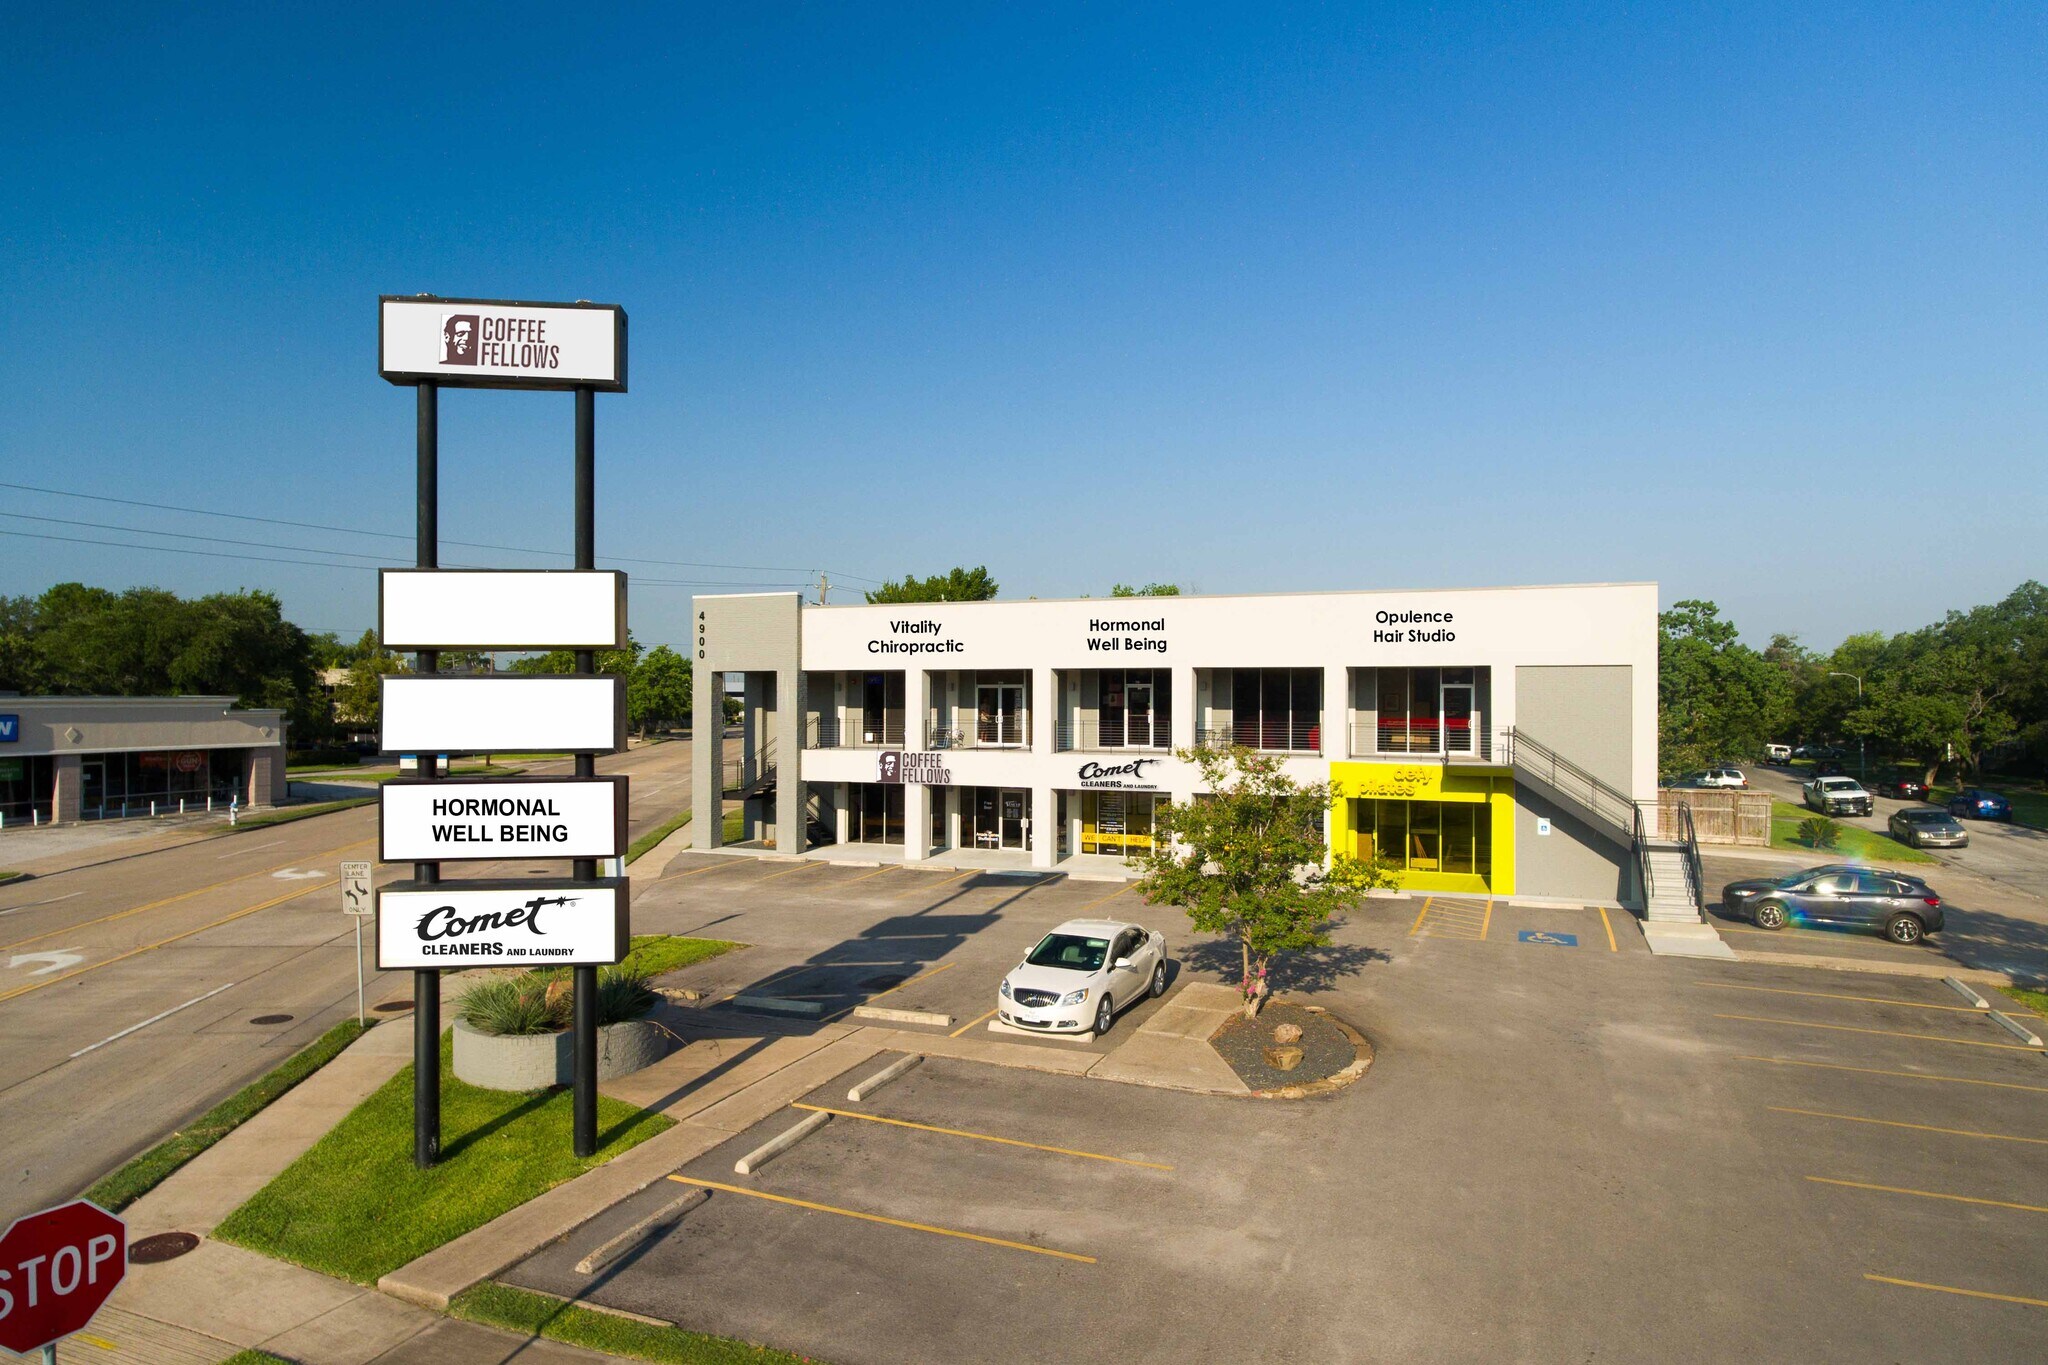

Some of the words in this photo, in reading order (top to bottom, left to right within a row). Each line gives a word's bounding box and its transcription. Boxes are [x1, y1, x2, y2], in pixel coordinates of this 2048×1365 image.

[482, 317, 546, 344] COFFEE
[481, 342, 560, 369] FELLOWS
[1089, 617, 1165, 632] Hormonal
[1375, 610, 1454, 626] Opulence
[698, 611, 706, 660] 4900
[890, 620, 942, 636] Vitality
[1373, 629, 1404, 643] Hair
[1408, 628, 1456, 643] Studio
[867, 639, 965, 656] Chiropractic
[1086, 637, 1119, 651] Well
[1124, 637, 1167, 653] Being
[902, 752, 942, 768] COFFEE
[902, 768, 951, 784] FELLOWS
[1078, 759, 1161, 780] Comet
[1394, 765, 1433, 786] defy
[1080, 780, 1122, 789] CLEANERS
[1359, 779, 1416, 797] pilates
[432, 798, 561, 817] HORMONAL
[432, 824, 494, 843] WELL
[500, 823, 569, 843] BEING
[413, 897, 583, 942] Comet
[422, 941, 504, 956] CLEANERS
[506, 948, 527, 956] AND
[528, 948, 575, 957] LAUNDRY
